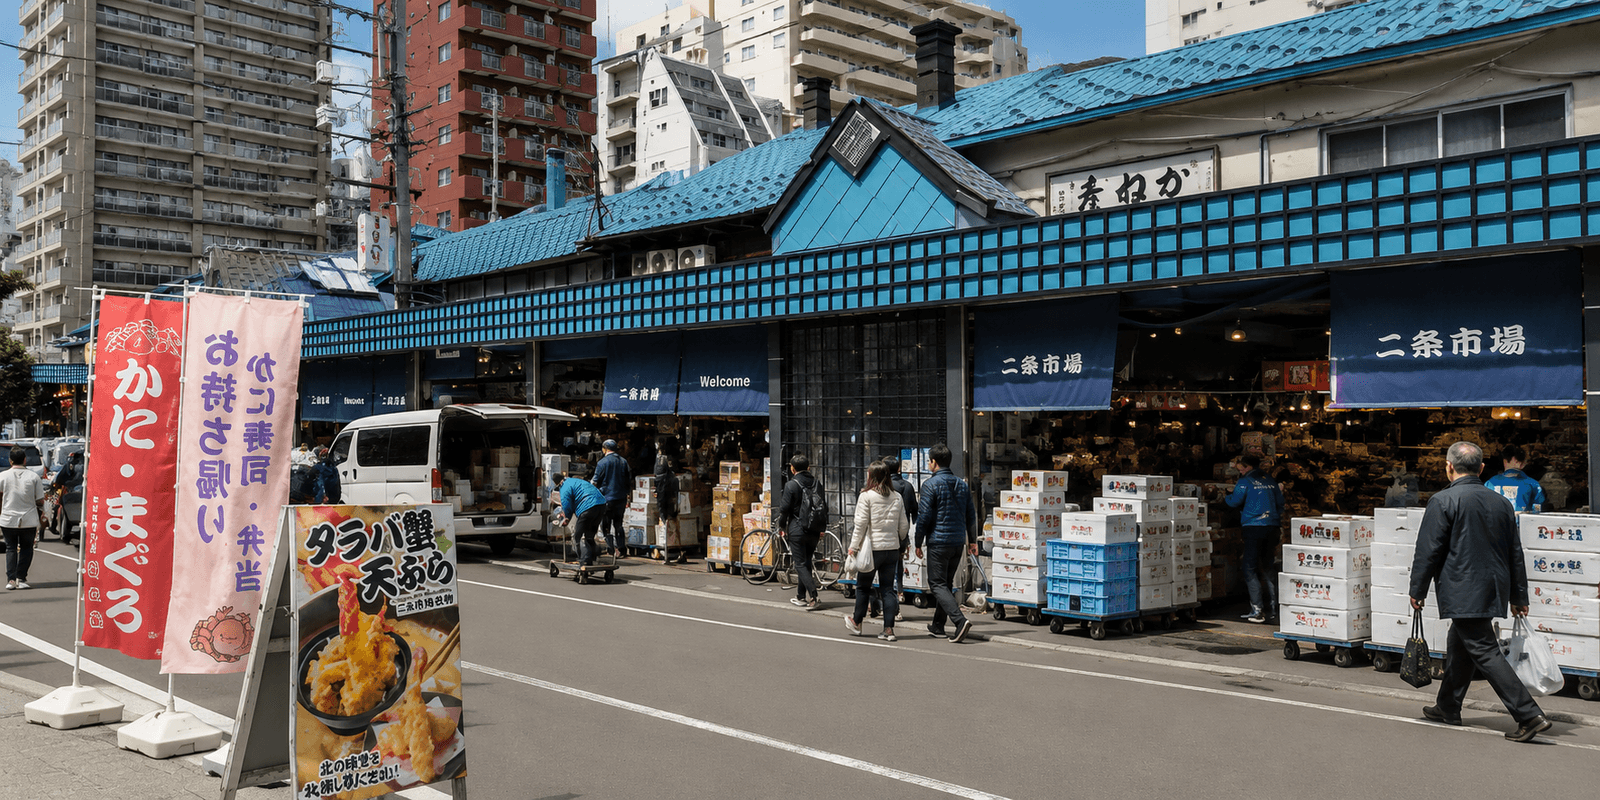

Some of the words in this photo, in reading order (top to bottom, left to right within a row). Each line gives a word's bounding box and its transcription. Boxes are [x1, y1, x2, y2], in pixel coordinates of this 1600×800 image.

[1375, 323, 1527, 359] 二条市場
[699, 375, 751, 388] Welcome
[1001, 352, 1083, 376] 二条市場
[103, 357, 163, 634] かに・まぐろ
[305, 508, 437, 567] タラバ蟹
